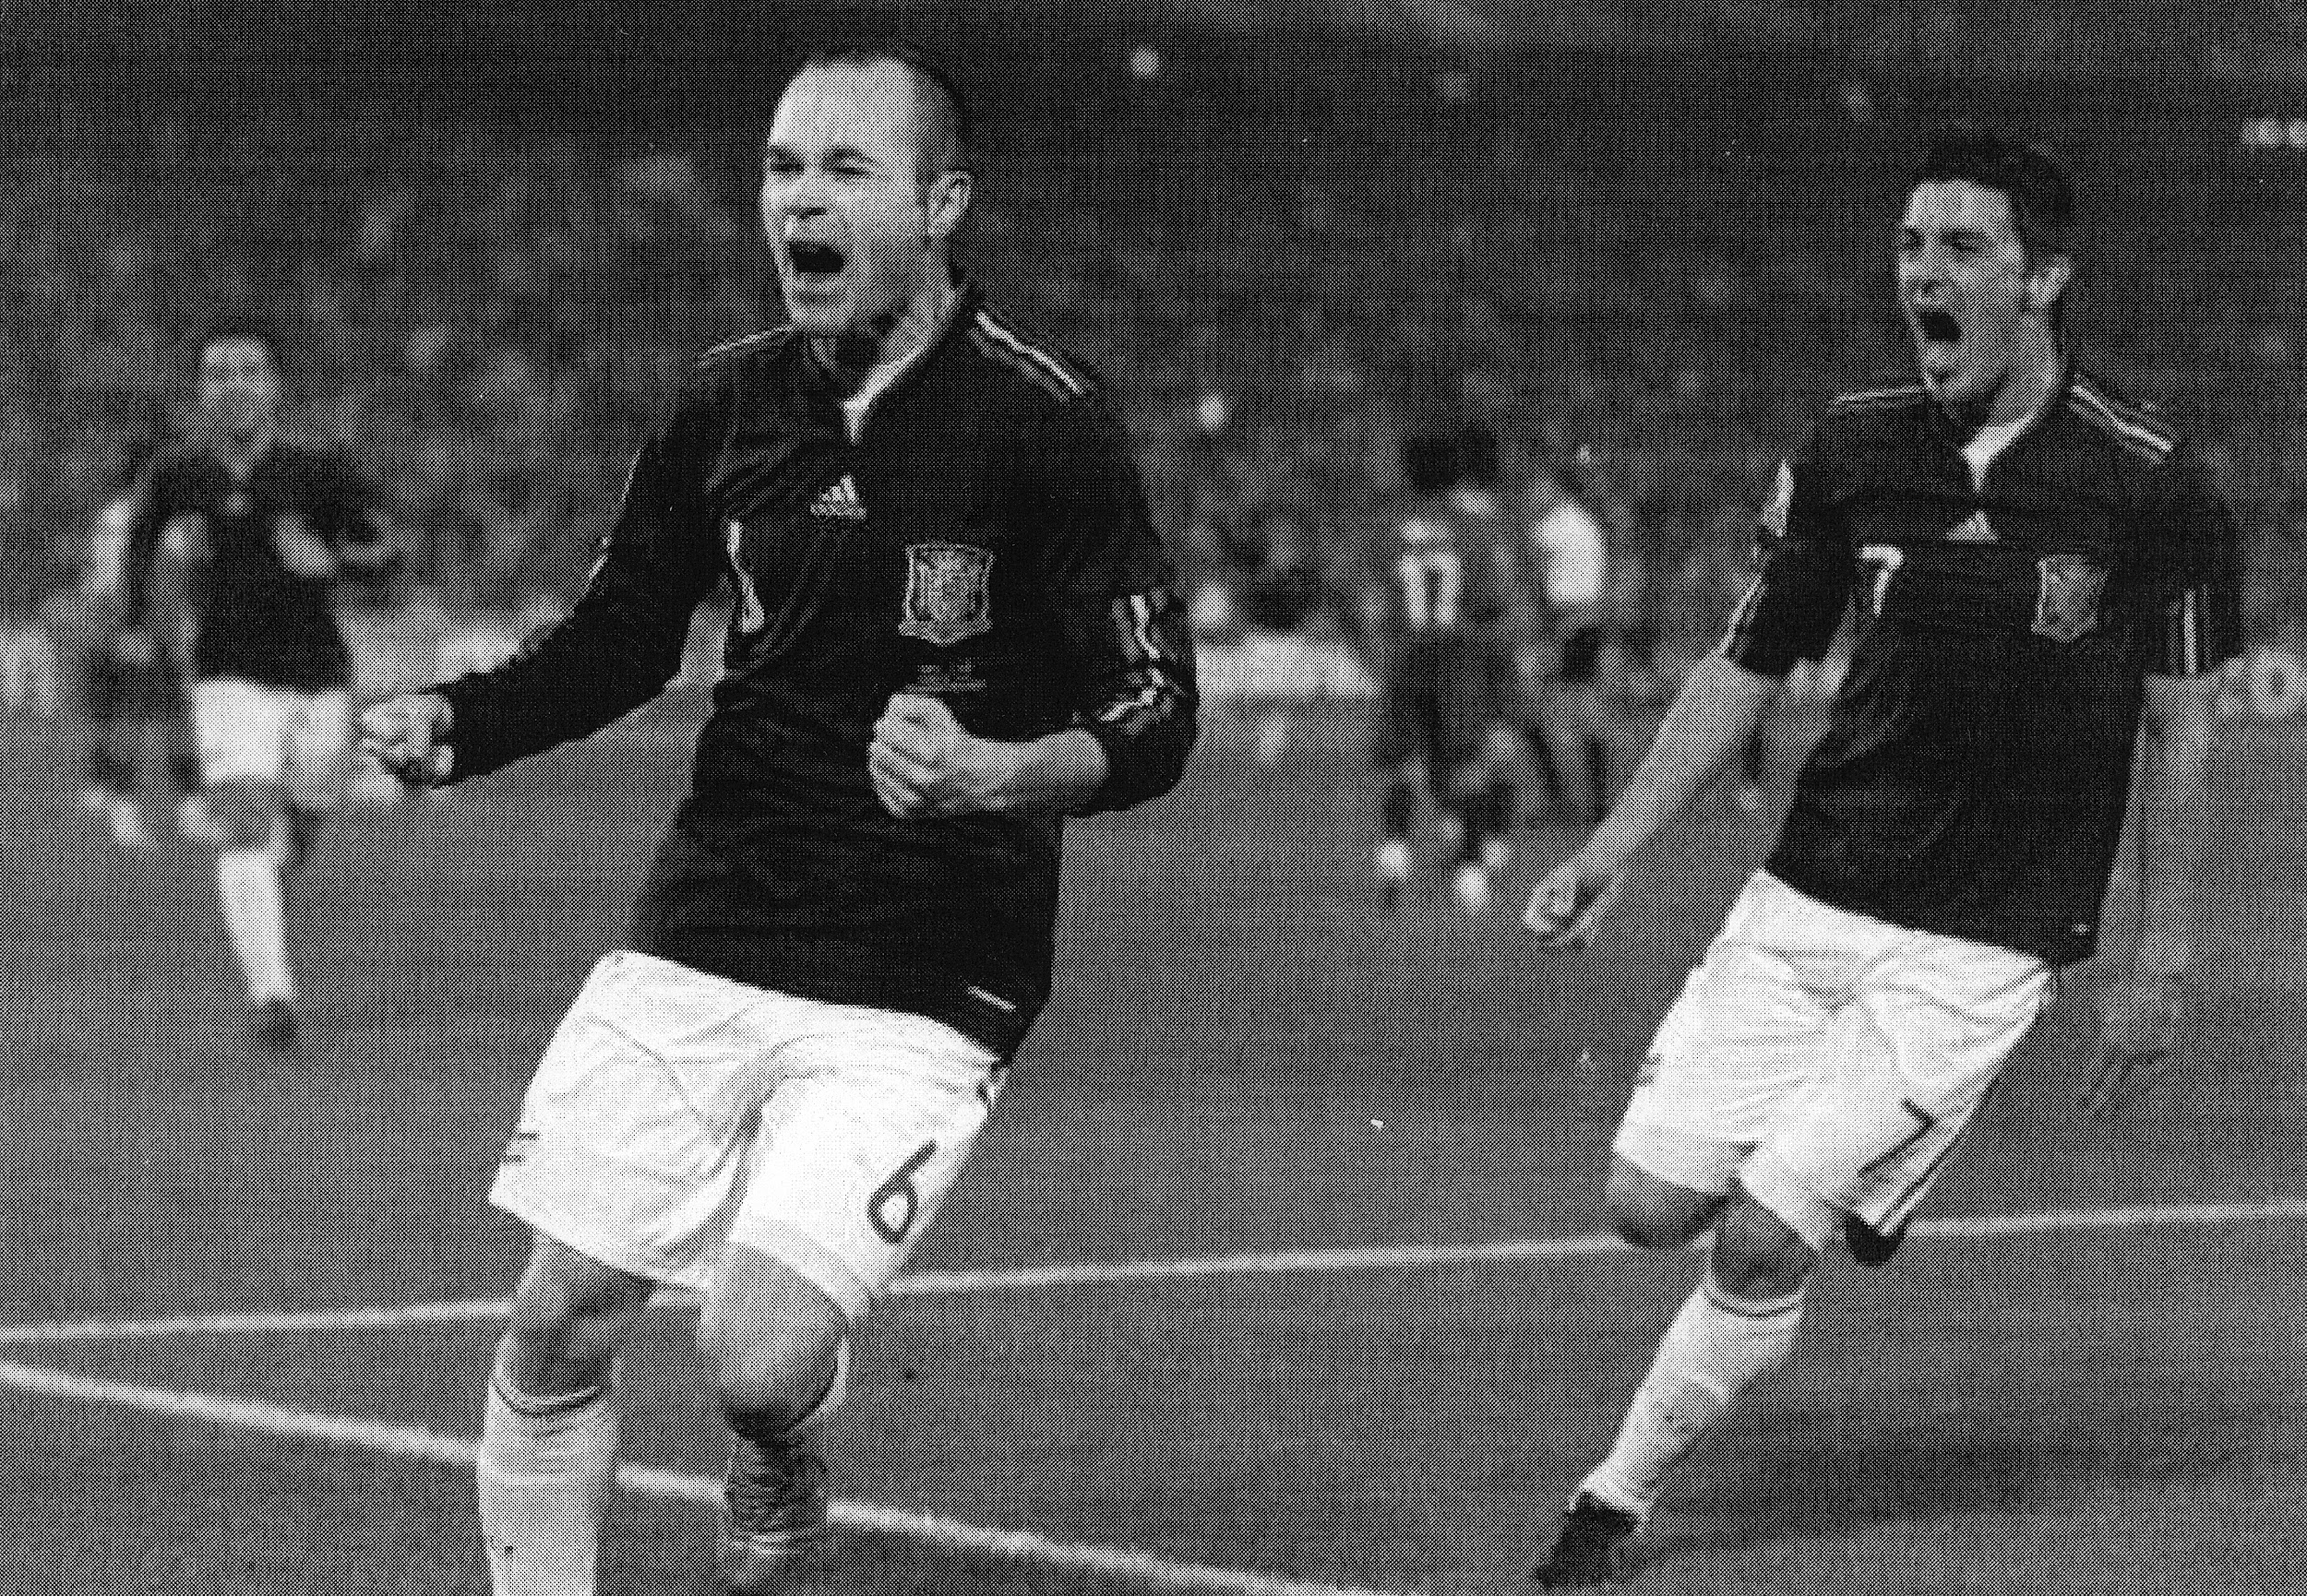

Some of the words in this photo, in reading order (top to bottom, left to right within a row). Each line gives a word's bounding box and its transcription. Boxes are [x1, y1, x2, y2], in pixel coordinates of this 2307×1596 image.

[1859, 544, 1904, 616] 7
[1857, 1097, 1938, 1178] 7
[867, 1140, 937, 1244] 6
